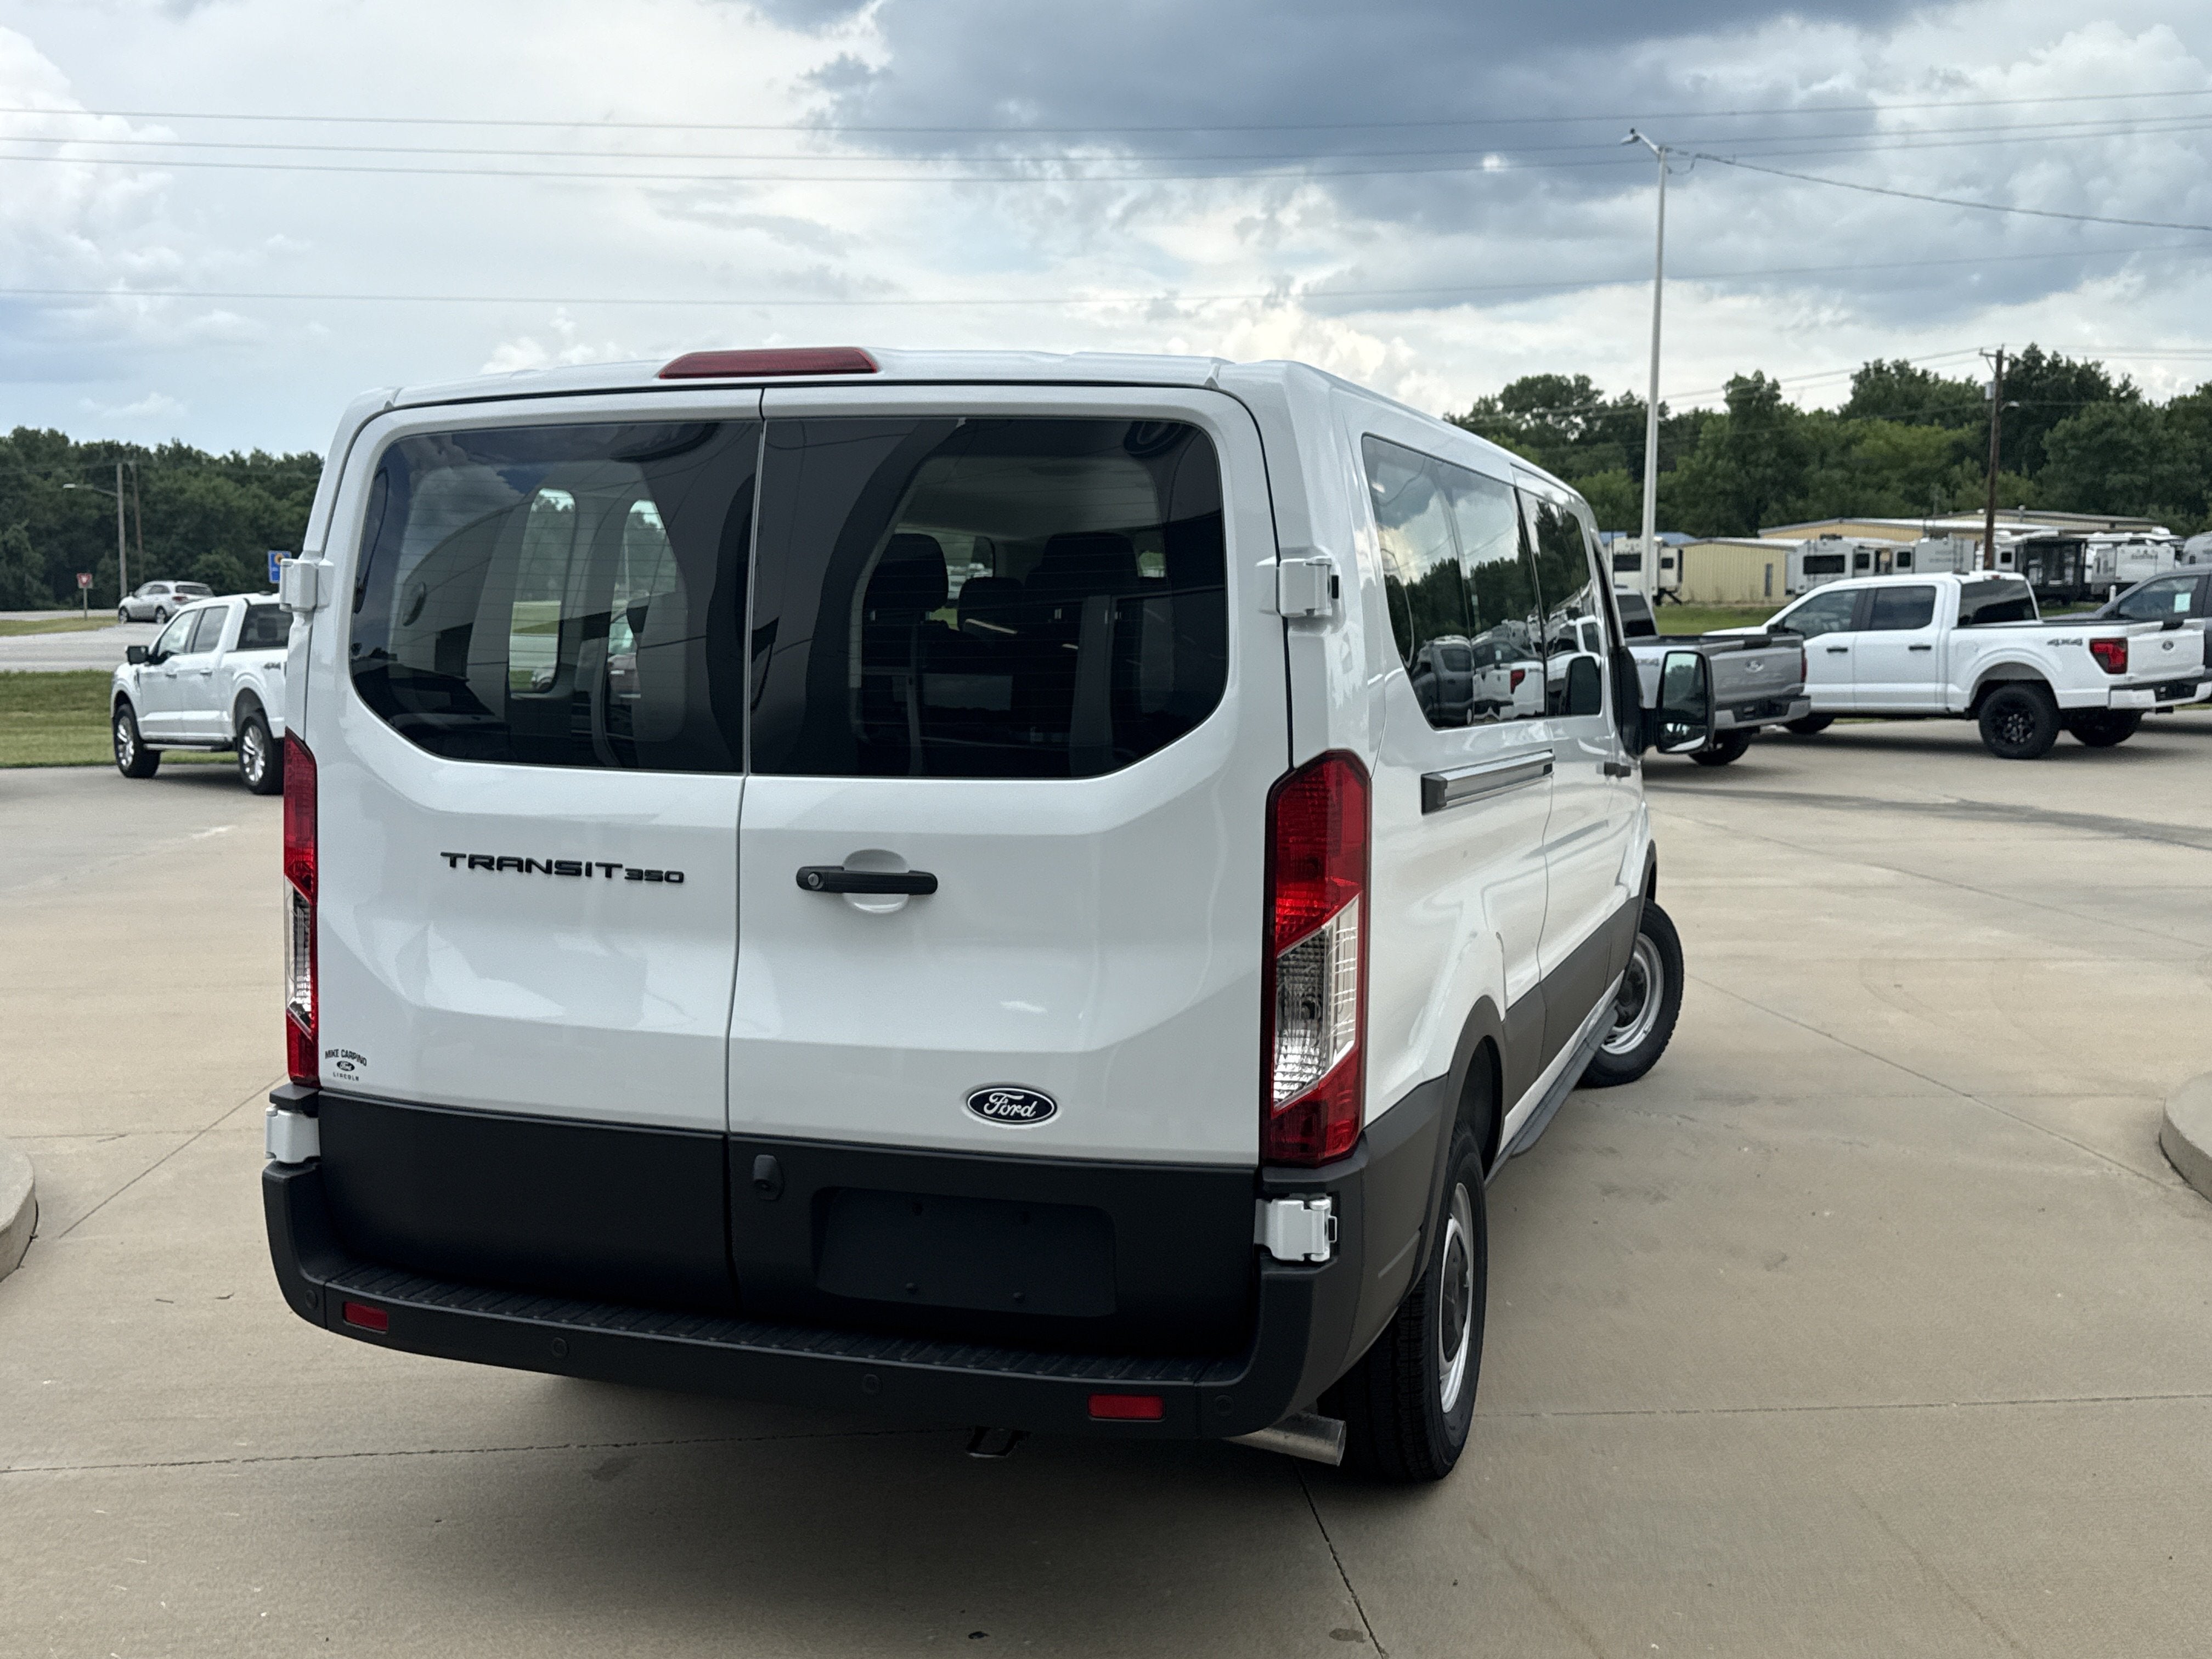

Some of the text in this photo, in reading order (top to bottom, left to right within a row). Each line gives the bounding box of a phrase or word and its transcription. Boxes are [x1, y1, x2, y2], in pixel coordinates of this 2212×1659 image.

[441, 851, 623, 878] TRANSIT
[325, 1049, 339, 1059] MIKE
[332, 1072, 359, 1081] LINCOLN
[984, 1092, 1038, 1117] Ford
